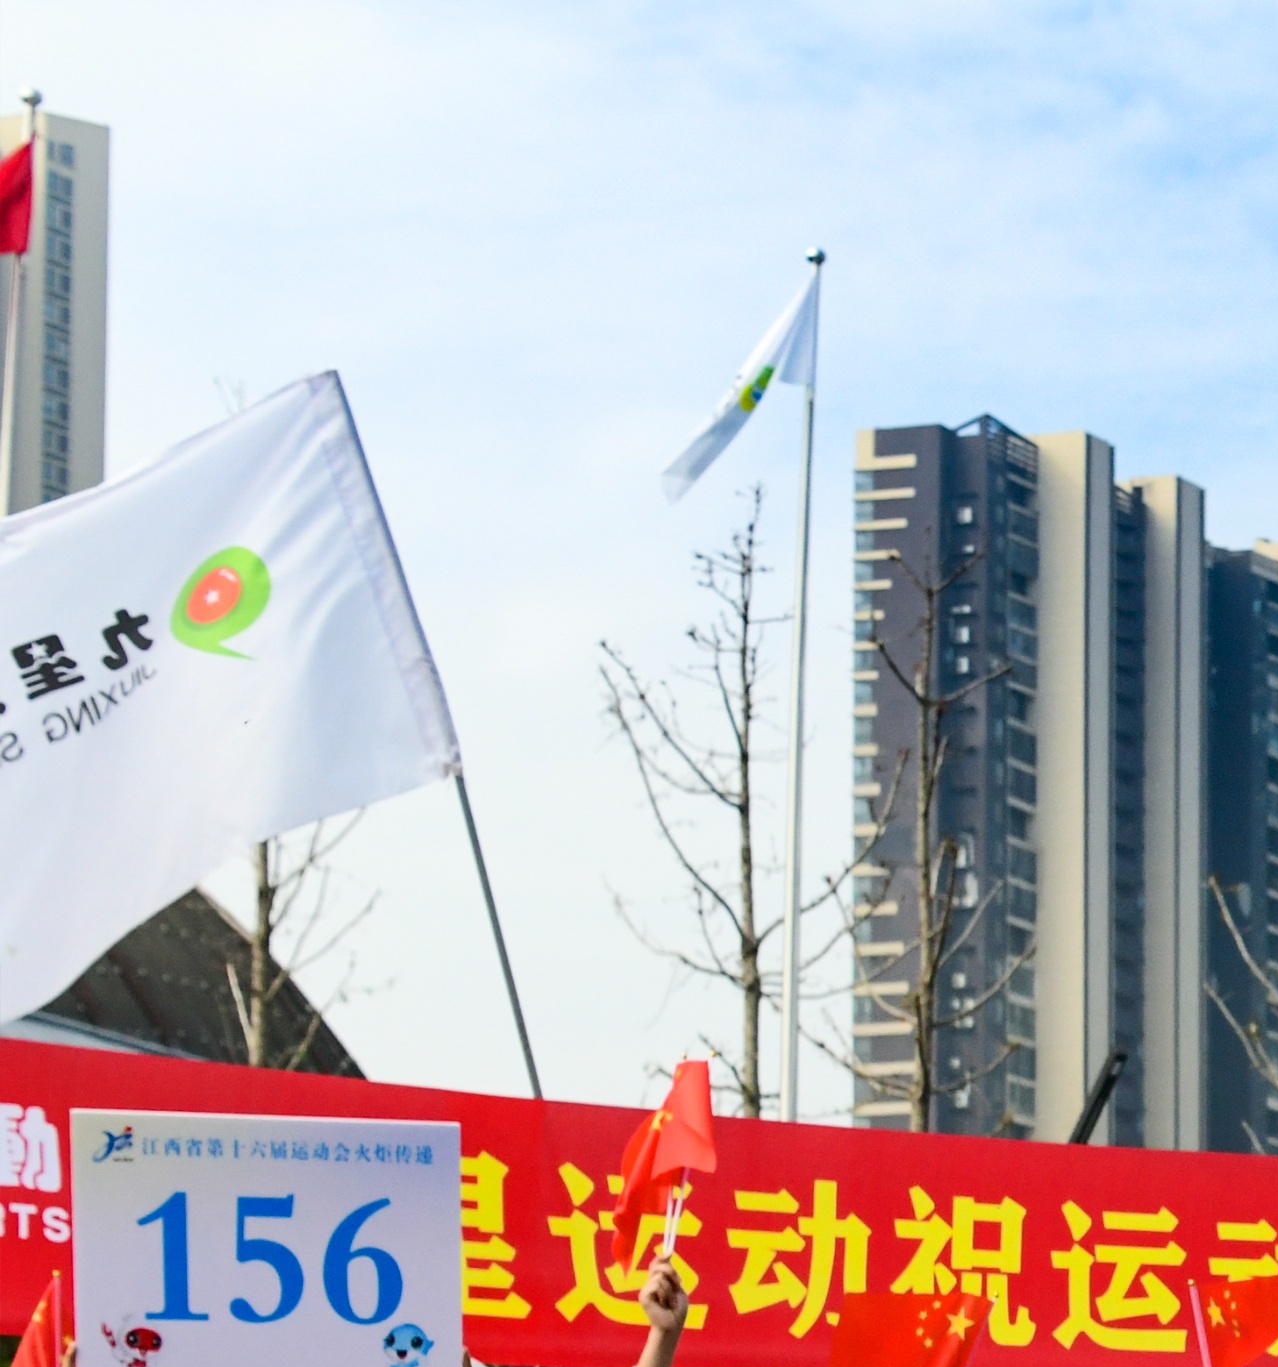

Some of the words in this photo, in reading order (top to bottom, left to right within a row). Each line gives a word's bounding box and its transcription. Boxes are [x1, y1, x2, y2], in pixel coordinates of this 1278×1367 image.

[141, 1136, 435, 1166] 江西省第十六届运动会火炬传递
[136, 1190, 404, 1325] 156
